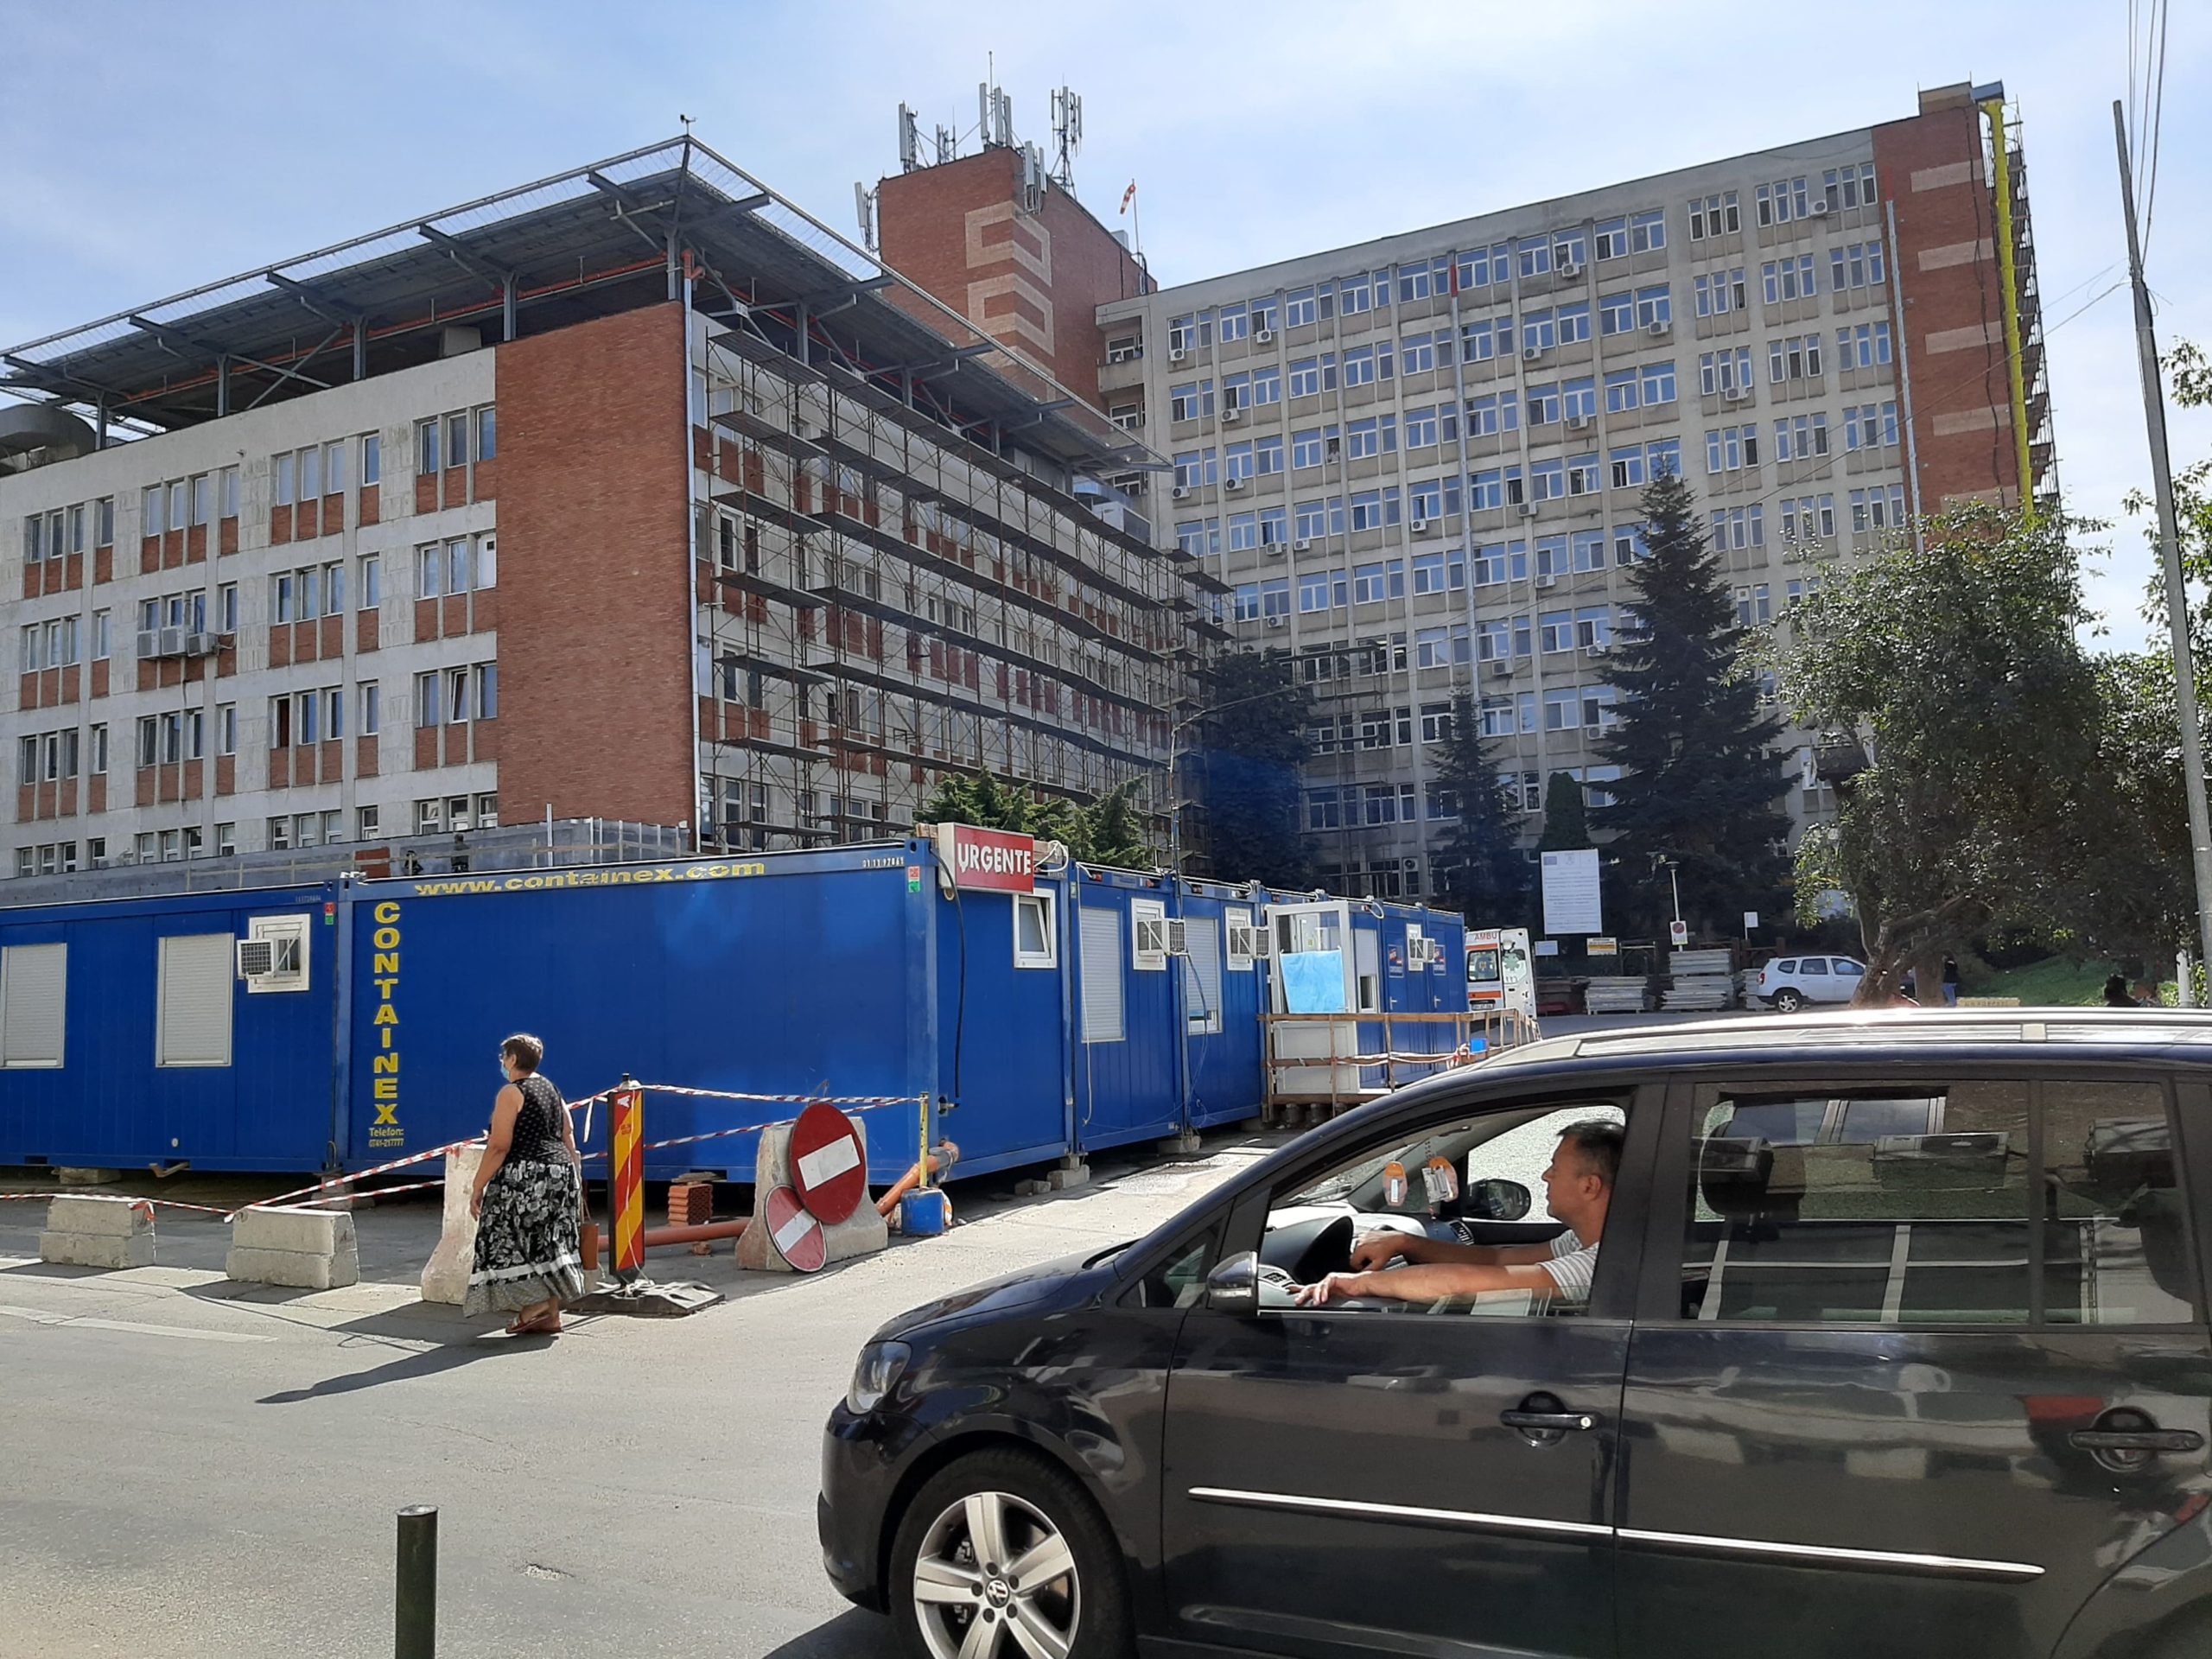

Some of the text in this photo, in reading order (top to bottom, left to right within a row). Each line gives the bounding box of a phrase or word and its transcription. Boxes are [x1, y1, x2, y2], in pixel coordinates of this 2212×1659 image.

[957, 842, 1031, 875] URGENTE
[415, 862, 765, 895] www.containex.com
[373, 902, 400, 1124] CONTAINEX
